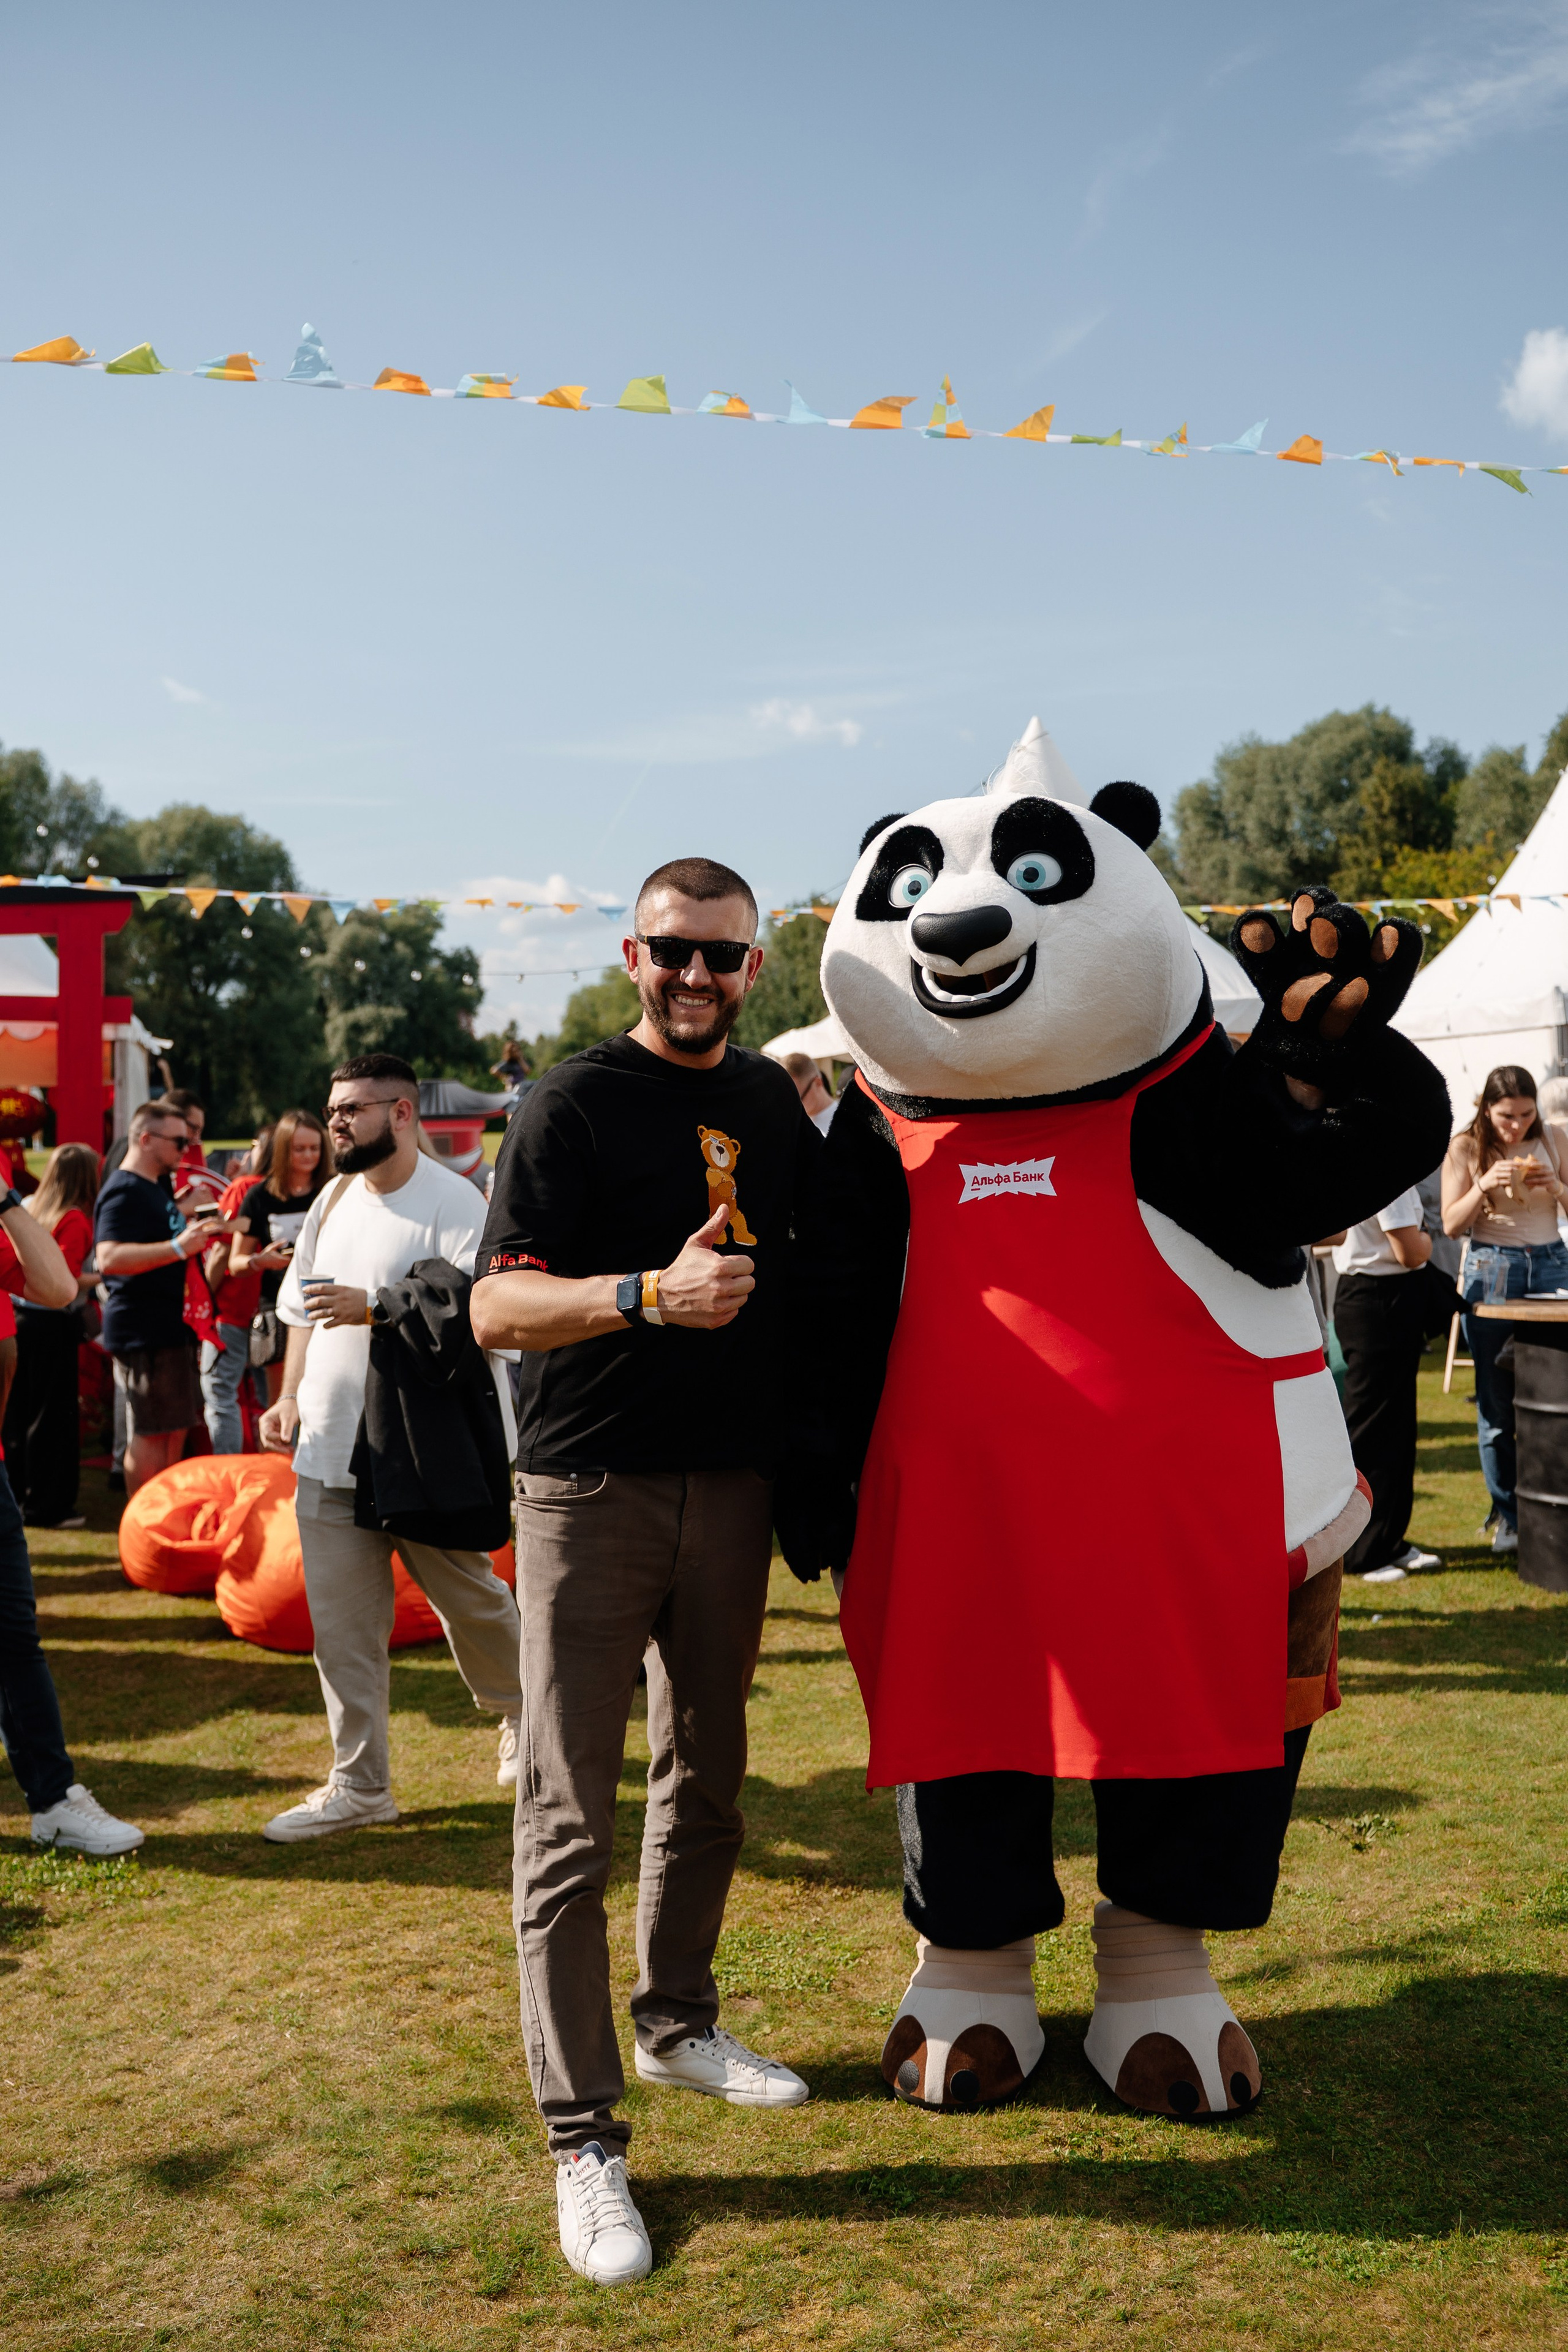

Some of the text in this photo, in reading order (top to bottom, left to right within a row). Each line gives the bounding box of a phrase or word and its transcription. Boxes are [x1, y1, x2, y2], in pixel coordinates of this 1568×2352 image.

[971, 1171, 1044, 1186] Альфа Банк
[489, 1254, 549, 1273] Alfa Bank
[578, 2162, 591, 2177] OSTE
